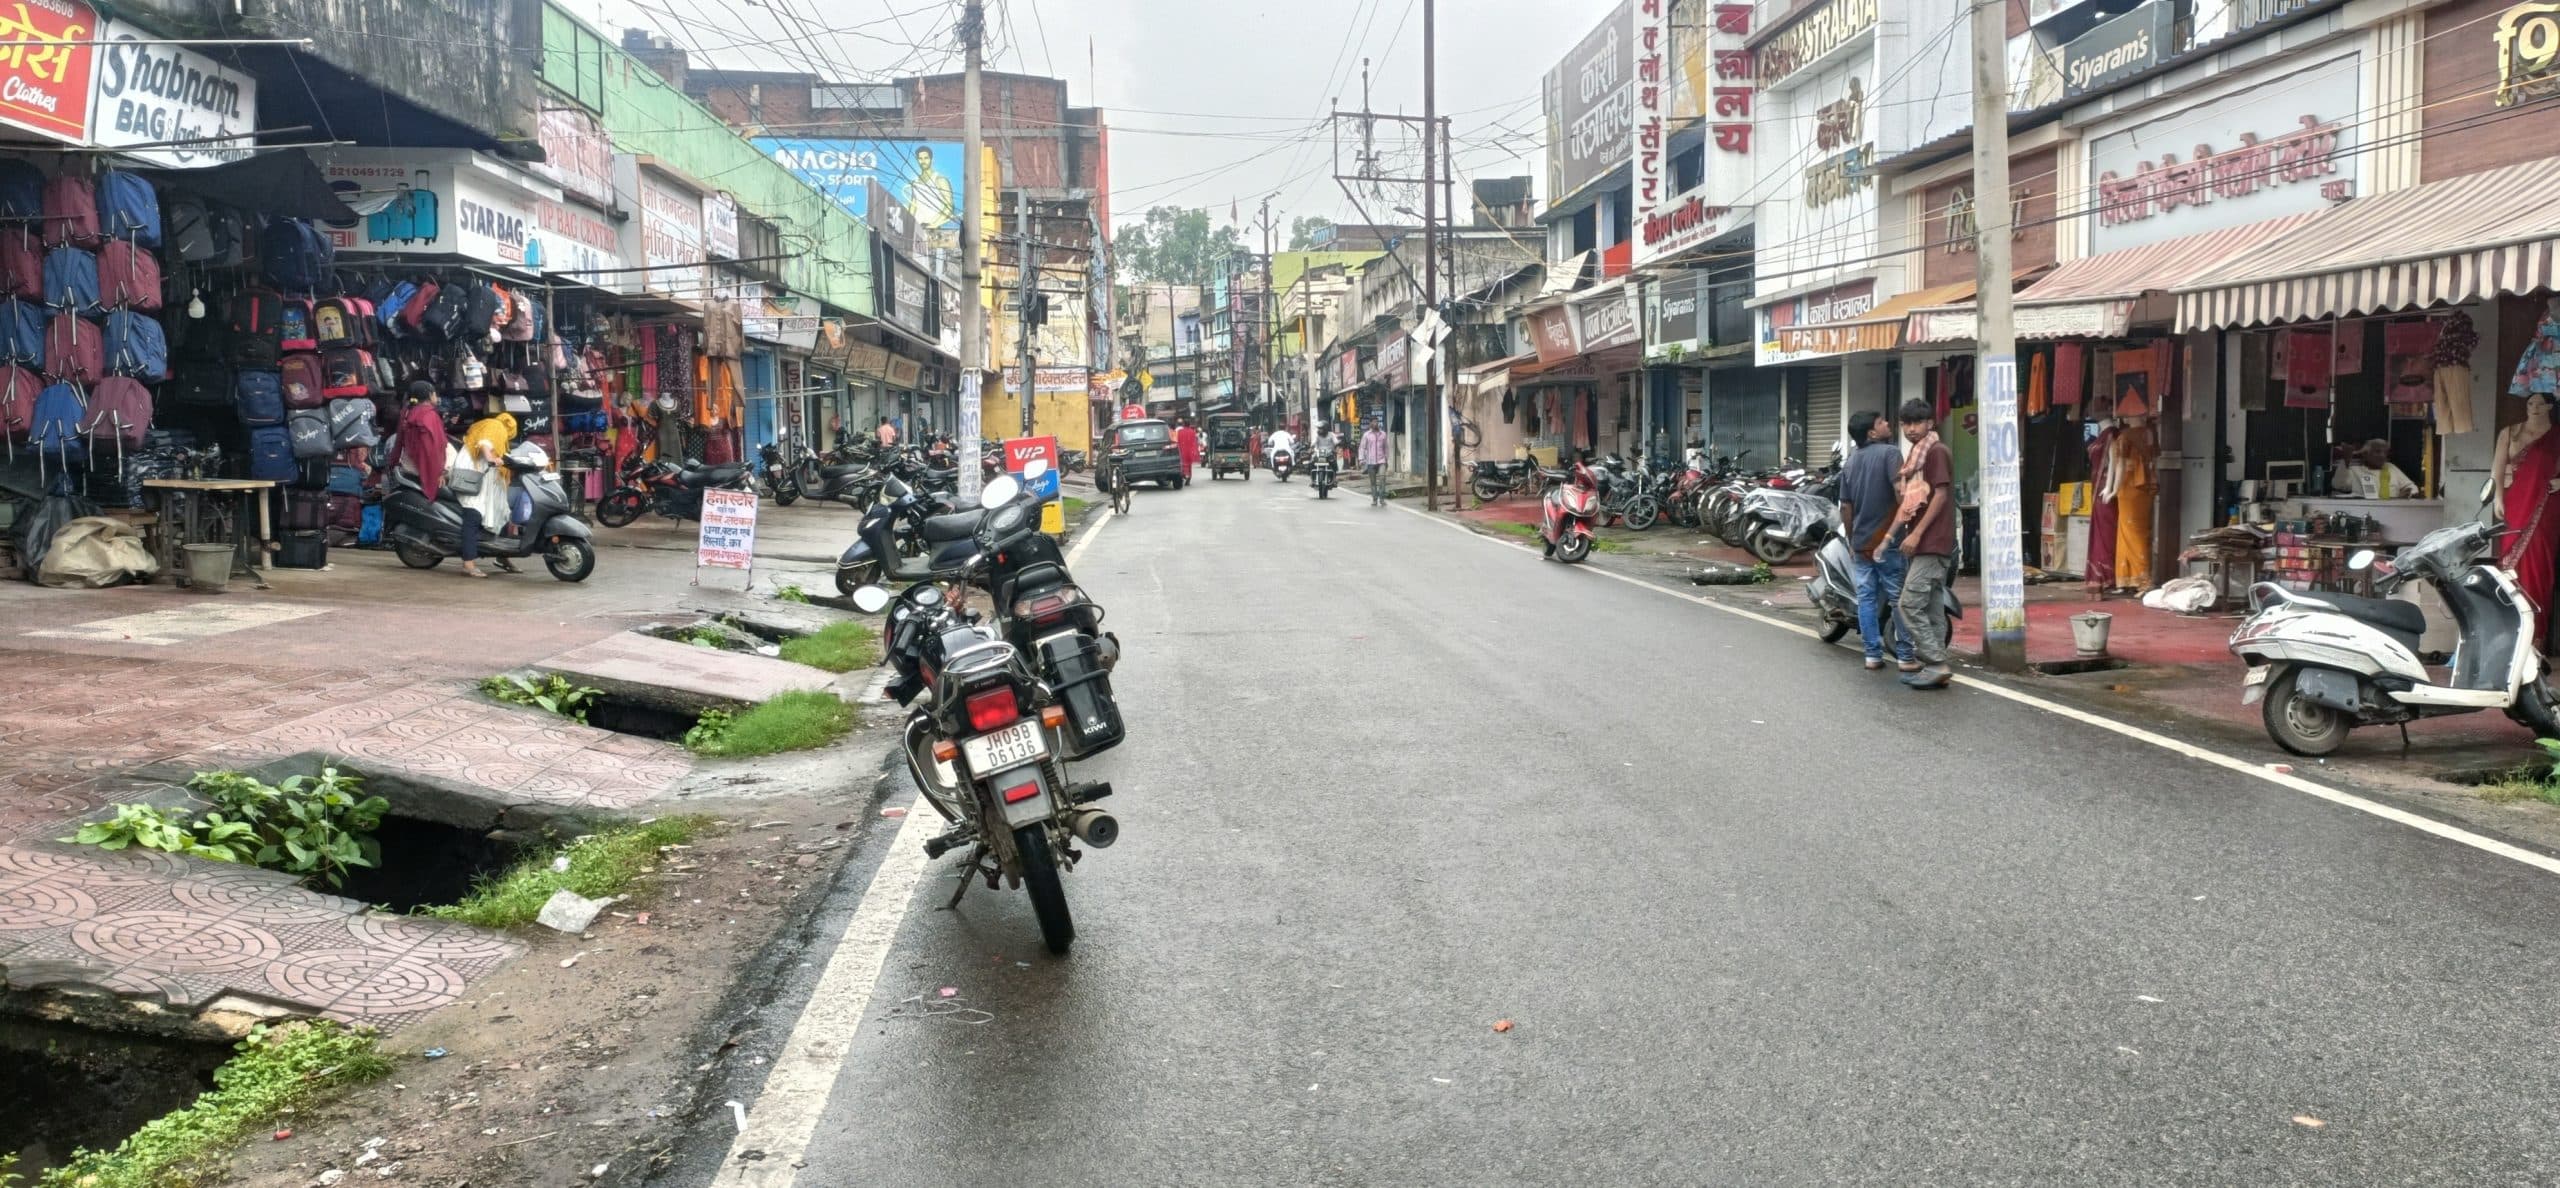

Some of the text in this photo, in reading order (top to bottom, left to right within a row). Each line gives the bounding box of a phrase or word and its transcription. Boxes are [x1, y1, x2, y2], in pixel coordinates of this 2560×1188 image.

[1580, 25, 1618, 104] काशी
[2067, 29, 2149, 88] Siyaram's
[102, 34, 241, 119] Shabnam
[3, 76, 57, 112] Clothes
[115, 99, 166, 140] BAG
[775, 149, 877, 170] MACHO
[460, 199, 495, 239] STAR
[497, 211, 523, 247] BAG
[556, 207, 577, 239] BAG
[580, 218, 616, 254] CENTER
[1809, 296, 1831, 324] काशी
[1791, 326, 1859, 348] PRIYA
[1987, 364, 2016, 401] ALL
[331, 404, 355, 424] NIKE
[1013, 446, 1046, 460] VIP
[1986, 421, 2017, 464] RO
[1995, 518, 2017, 534] CALL
[985, 724, 1031, 751] JH09B
[1083, 721, 1108, 735] KIWI
[988, 741, 1036, 767] D6136
